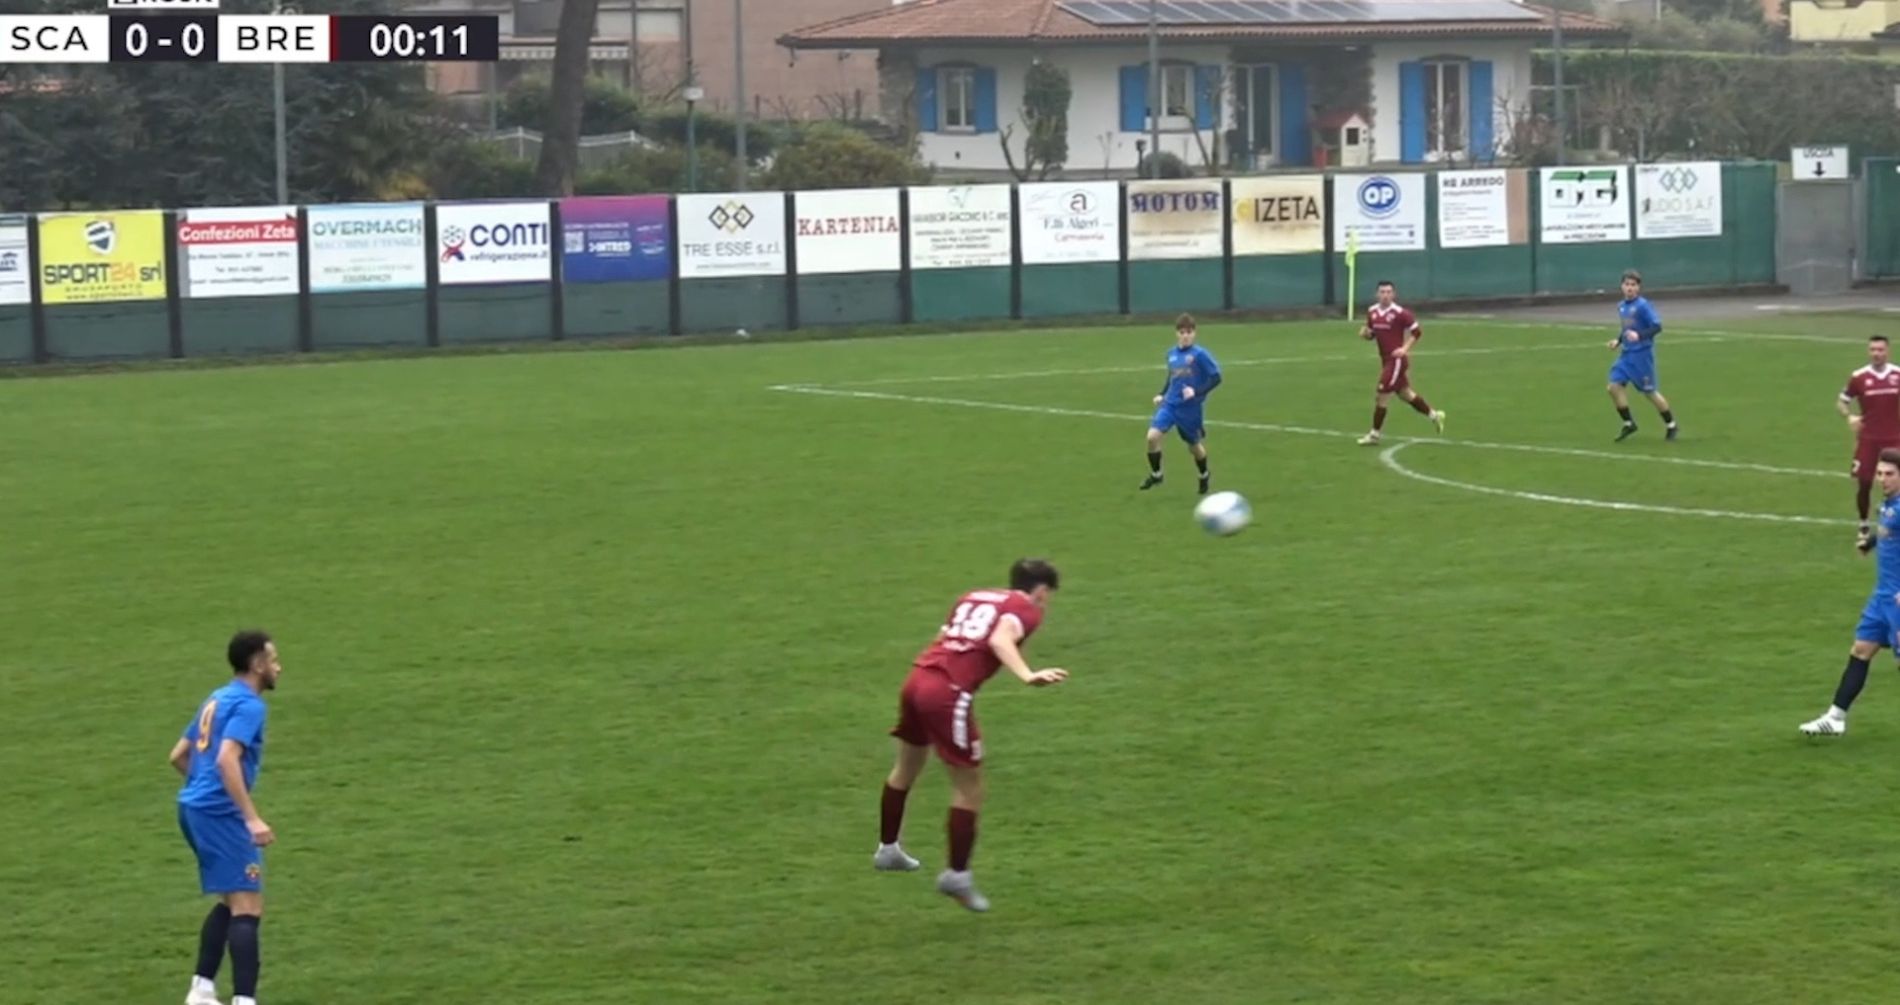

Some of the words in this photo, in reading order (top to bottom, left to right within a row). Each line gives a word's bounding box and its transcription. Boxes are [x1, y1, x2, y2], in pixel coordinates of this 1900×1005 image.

[1131, 191, 1220, 213] MOTOM
[1364, 186, 1395, 205] OP
[180, 225, 260, 242] Confezioni
[262, 224, 296, 240] Zeta
[312, 218, 422, 236] OVERMACH
[470, 223, 548, 247] CONTI
[798, 215, 899, 236] KARTENIA
[683, 243, 712, 257] TRE
[715, 241, 754, 257] ESSE
[140, 261, 162, 282] srl
[197, 700, 217, 753] 9
